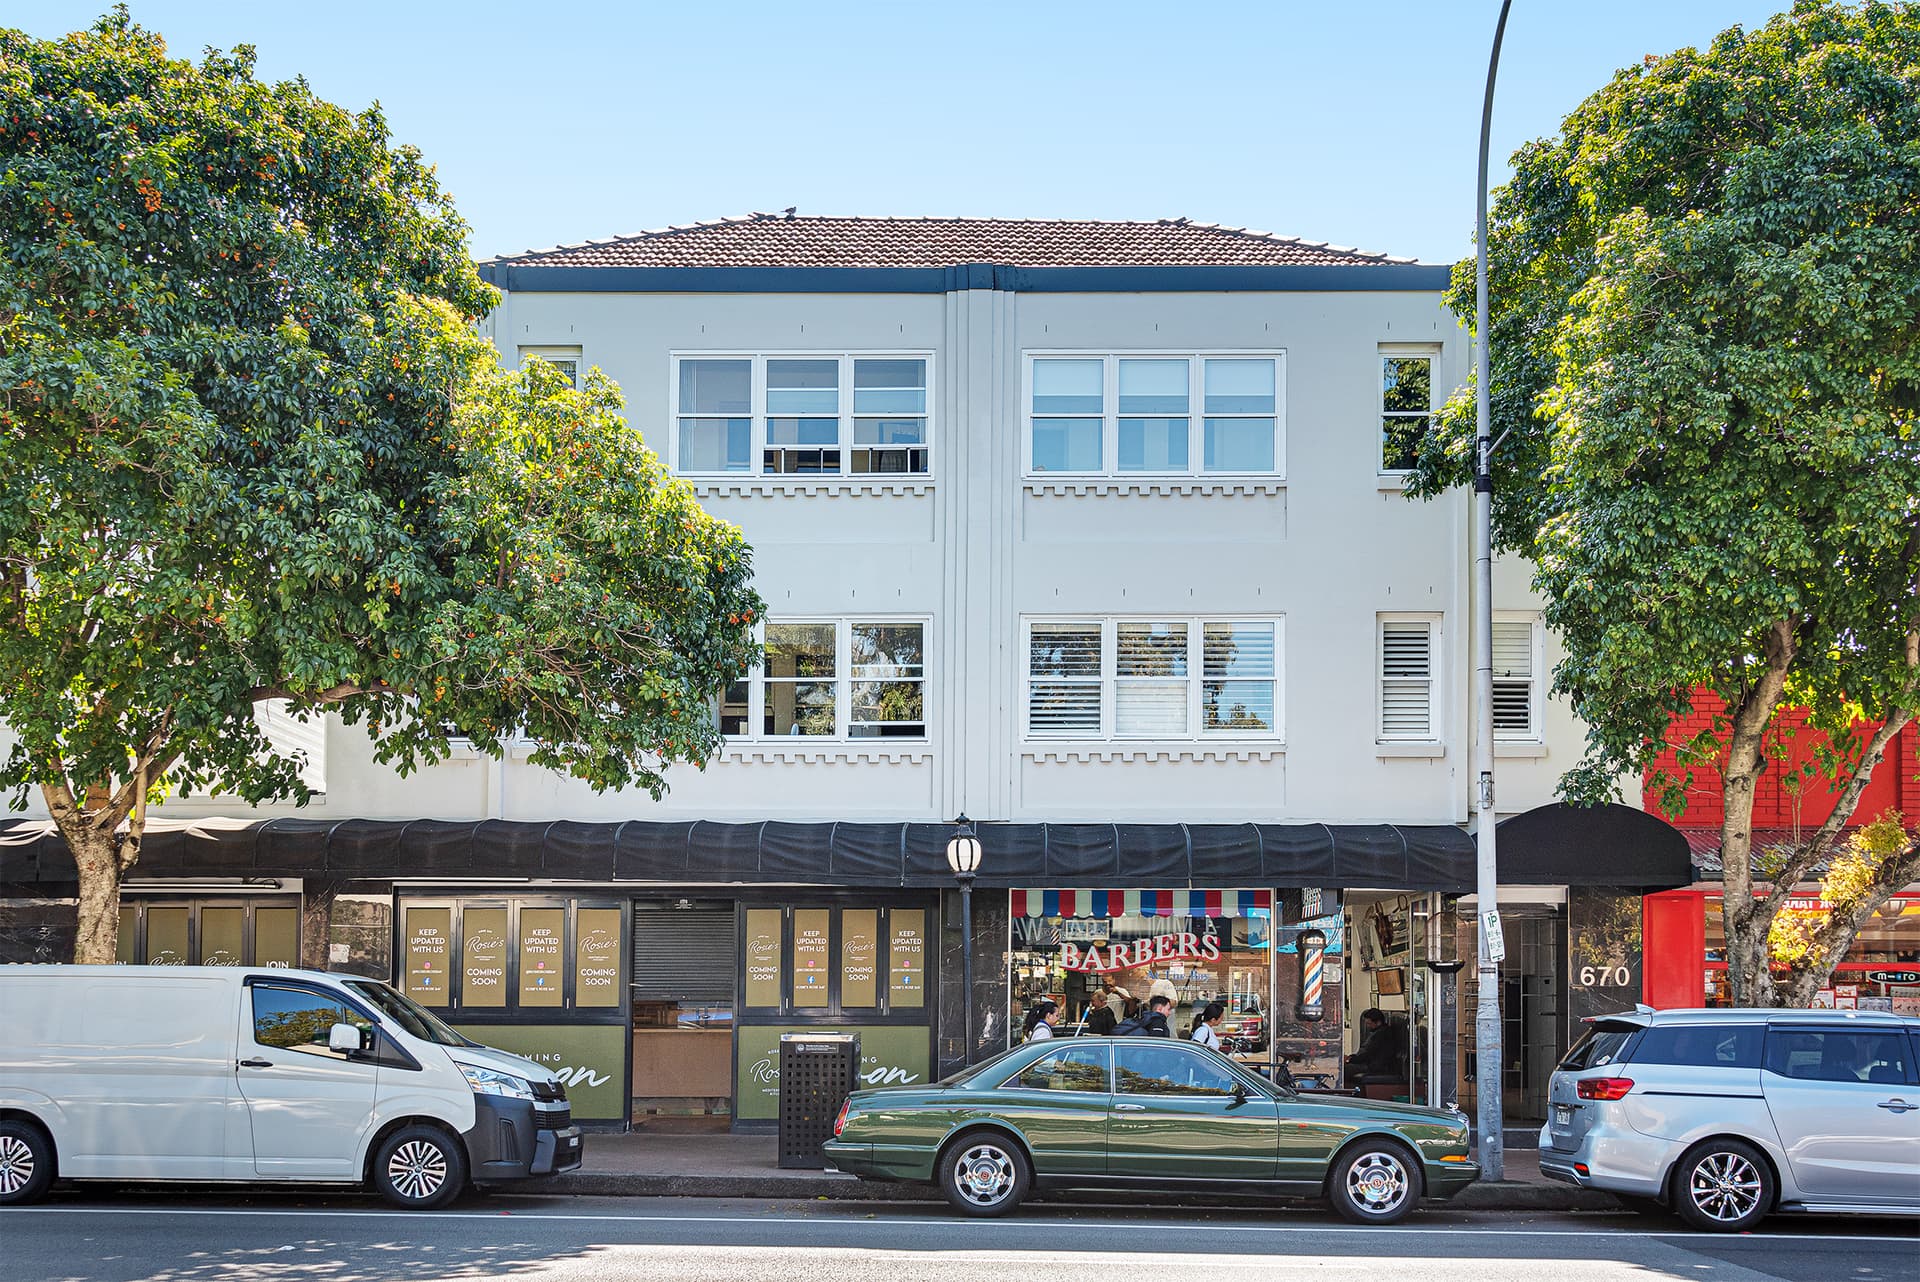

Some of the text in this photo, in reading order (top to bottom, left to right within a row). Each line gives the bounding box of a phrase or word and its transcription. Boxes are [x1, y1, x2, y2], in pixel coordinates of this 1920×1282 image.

[466, 936, 504, 952] Rosie's
[580, 936, 618, 953] Rosie's
[1059, 932, 1221, 972] BARBERS
[467, 968, 503, 976] COMING
[580, 968, 616, 976] COMING
[1580, 966, 1631, 987] 670
[585, 978, 611, 986] SOON
[524, 1053, 562, 1062] MING
